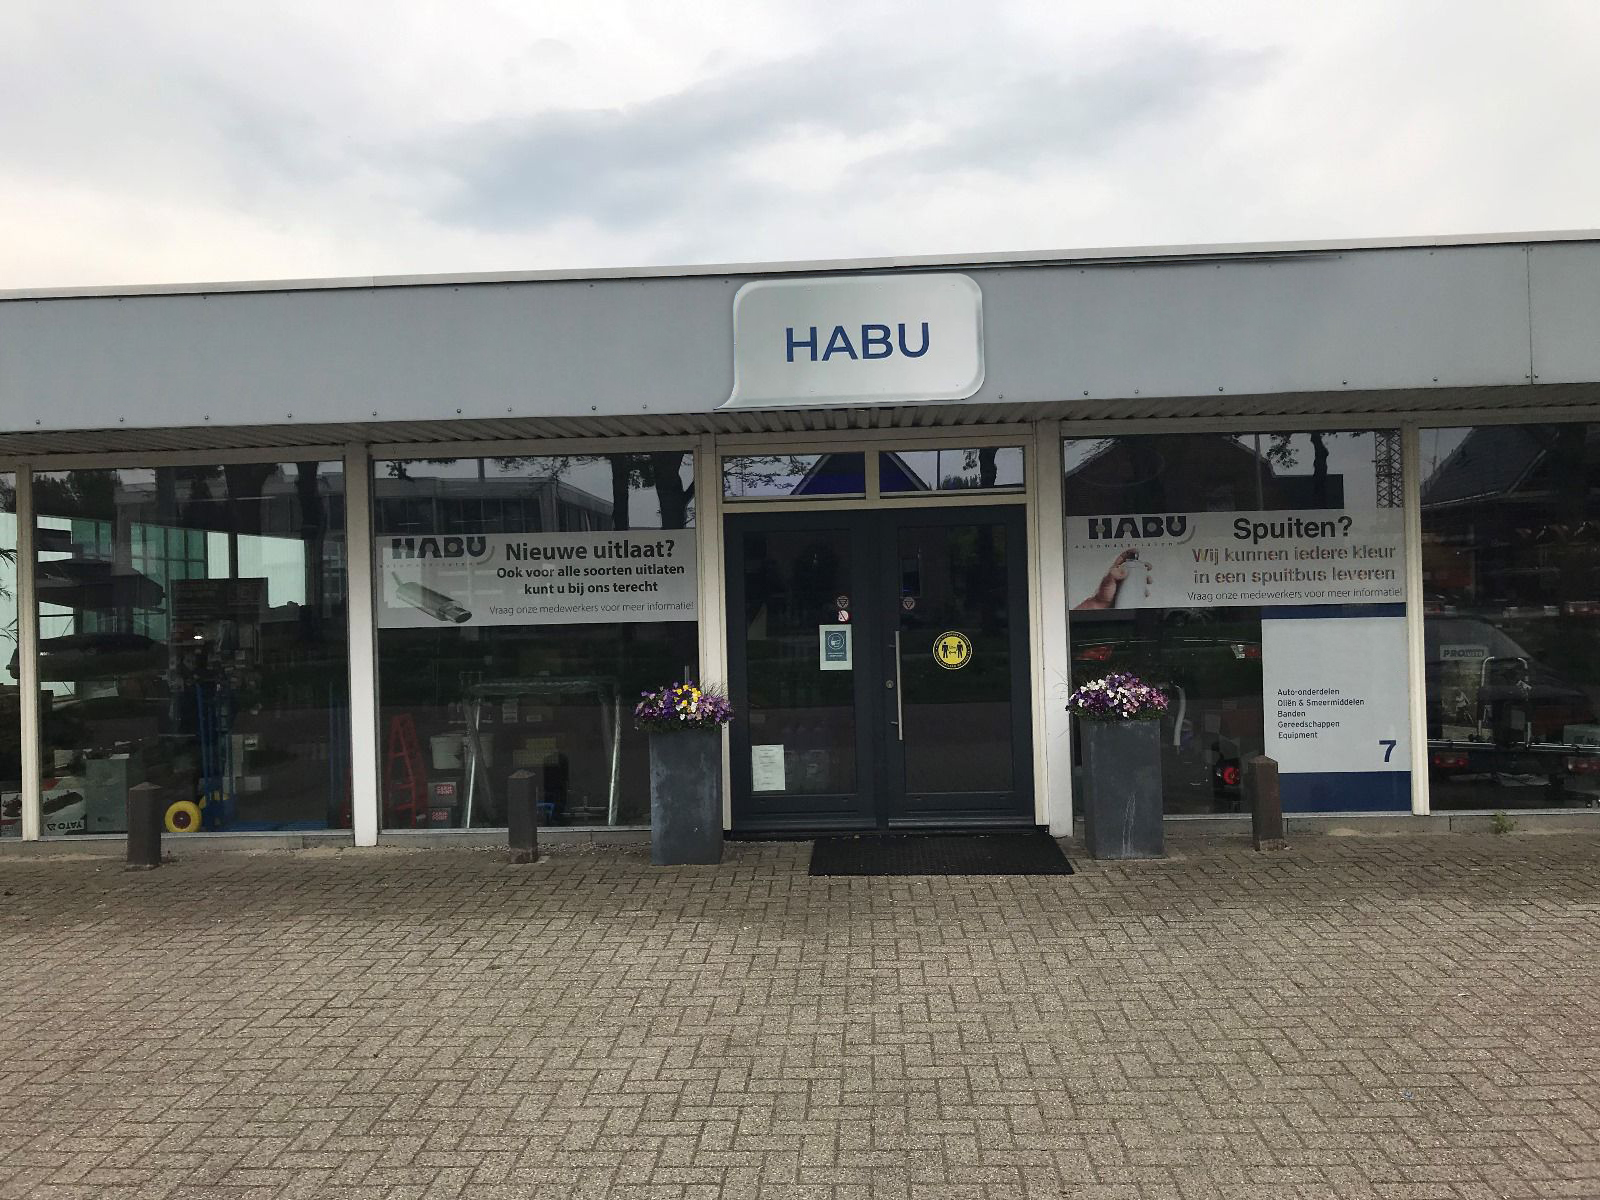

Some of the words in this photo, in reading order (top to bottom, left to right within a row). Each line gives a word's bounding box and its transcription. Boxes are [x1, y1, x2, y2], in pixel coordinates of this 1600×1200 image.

[785, 321, 930, 363] HABU
[1088, 515, 1187, 539] HABU
[1233, 515, 1353, 544] Spuiten?
[391, 535, 487, 559] HABU
[505, 542, 588, 561] Nieuwe
[593, 539, 675, 559] uitlaat?
[1191, 548, 1219, 565] Wij
[1224, 547, 1289, 562] kunnen
[1294, 546, 1348, 560] iedere
[1352, 545, 1396, 559] kleur
[496, 566, 523, 578] Ook
[525, 567, 554, 578] voor
[557, 566, 581, 577] alle
[583, 565, 633, 576] soorten
[635, 564, 685, 575] uitlaten
[1193, 570, 1210, 584] in
[1214, 571, 1246, 583] een
[1251, 567, 1327, 586] spuitbus
[1332, 566, 1395, 581] leveren
[524, 583, 554, 595] kunt
[557, 585, 566, 594] u
[568, 582, 585, 596] bij
[587, 583, 610, 593] ons
[613, 581, 658, 592] terecht
[1187, 591, 1213, 602] Vraag
[1215, 592, 1238, 600] onze
[1240, 590, 1302, 600] medewerkers
[1304, 590, 1325, 598] voor
[1327, 590, 1350, 598] meer
[489, 605, 514, 616] Vraag
[516, 605, 537, 614] onze
[539, 603, 598, 614] medewerkers
[600, 603, 620, 612] voor
[622, 602, 644, 612] meer
[647, 601, 694, 611] informatie!
[1277, 688, 1340, 696] Auto-onderdelen
[1277, 699, 1296, 707] Oliën
[1306, 698, 1365, 706] Smeermiddelen
[1277, 710, 1306, 718] Banden
[1277, 720, 1340, 729] Gereedschappen
[1278, 731, 1318, 740] Equipment
[1379, 740, 1397, 763] 7
